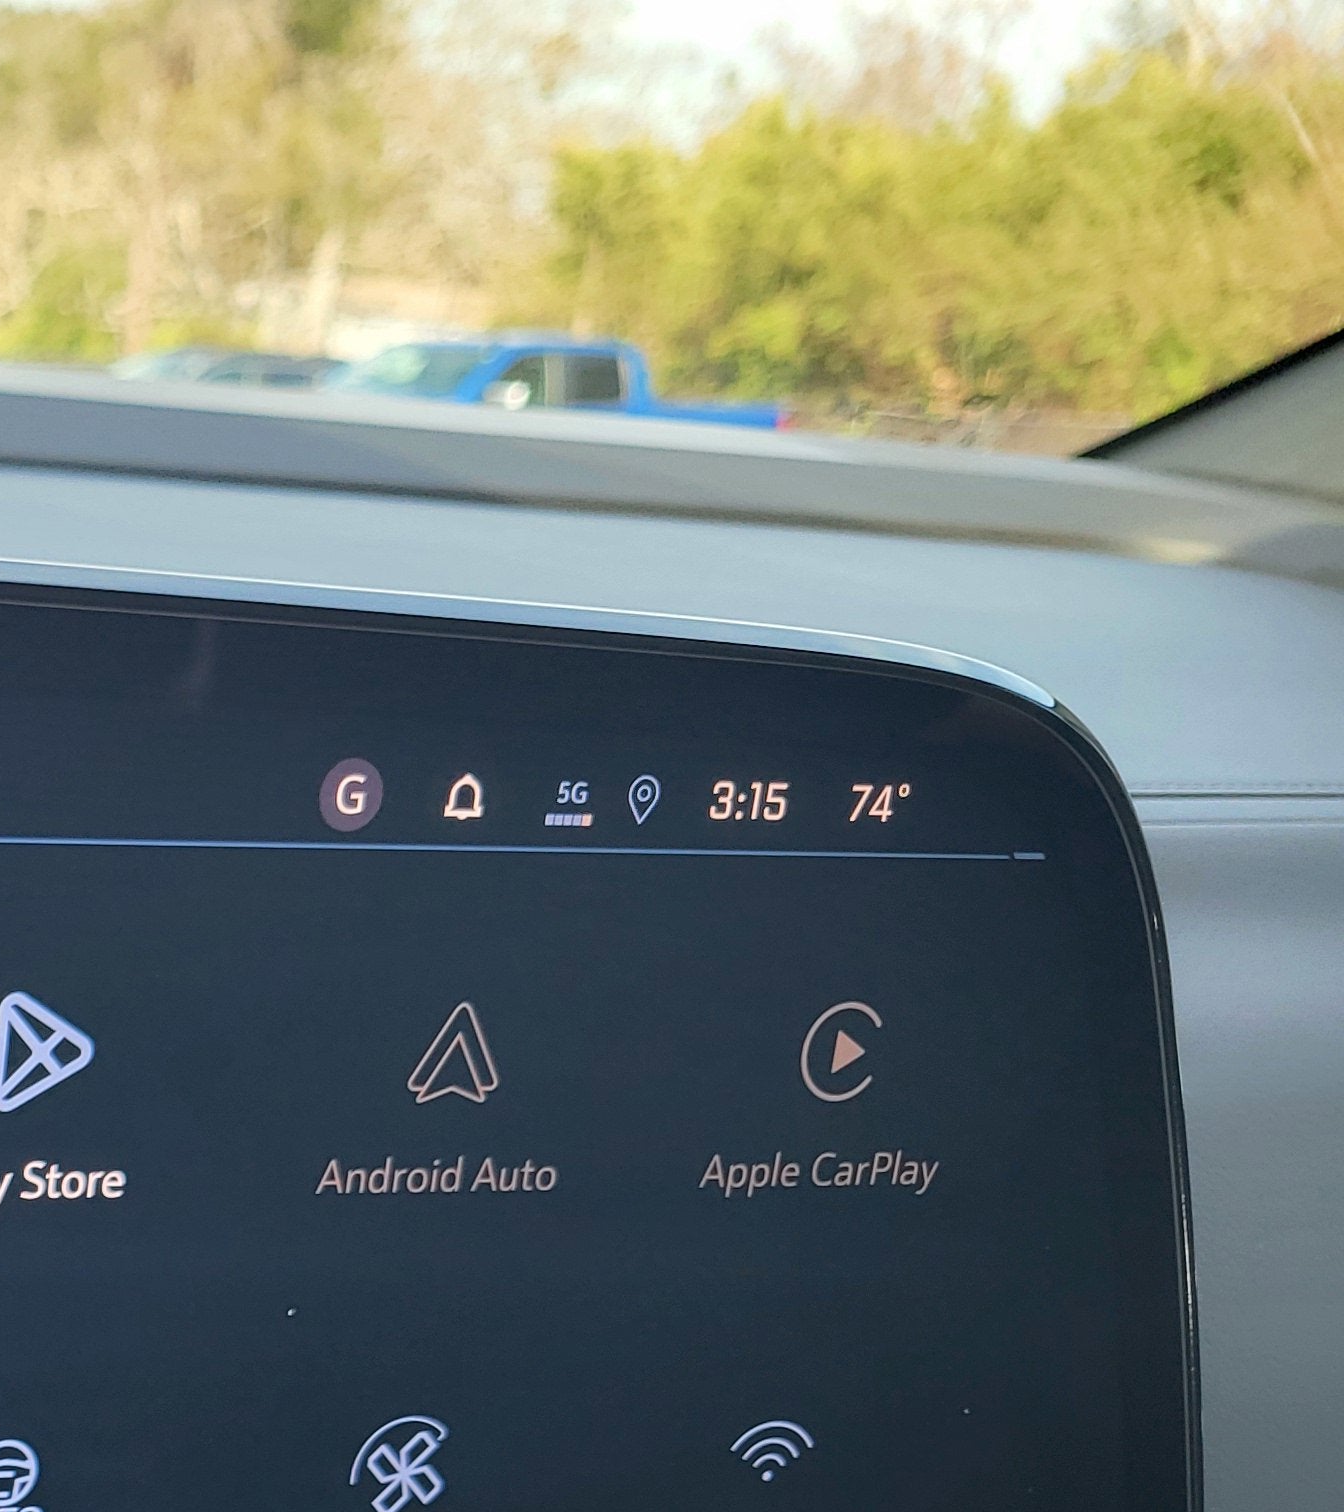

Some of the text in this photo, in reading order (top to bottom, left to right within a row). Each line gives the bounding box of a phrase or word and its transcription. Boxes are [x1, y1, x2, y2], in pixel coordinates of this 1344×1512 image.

[336, 774, 366, 815] G
[556, 780, 588, 804] 5G
[709, 780, 789, 821] 3:15
[19, 1160, 127, 1200] Store
[315, 1155, 557, 1195] Android Auto
[698, 1149, 940, 1198] Apple CarPlay
